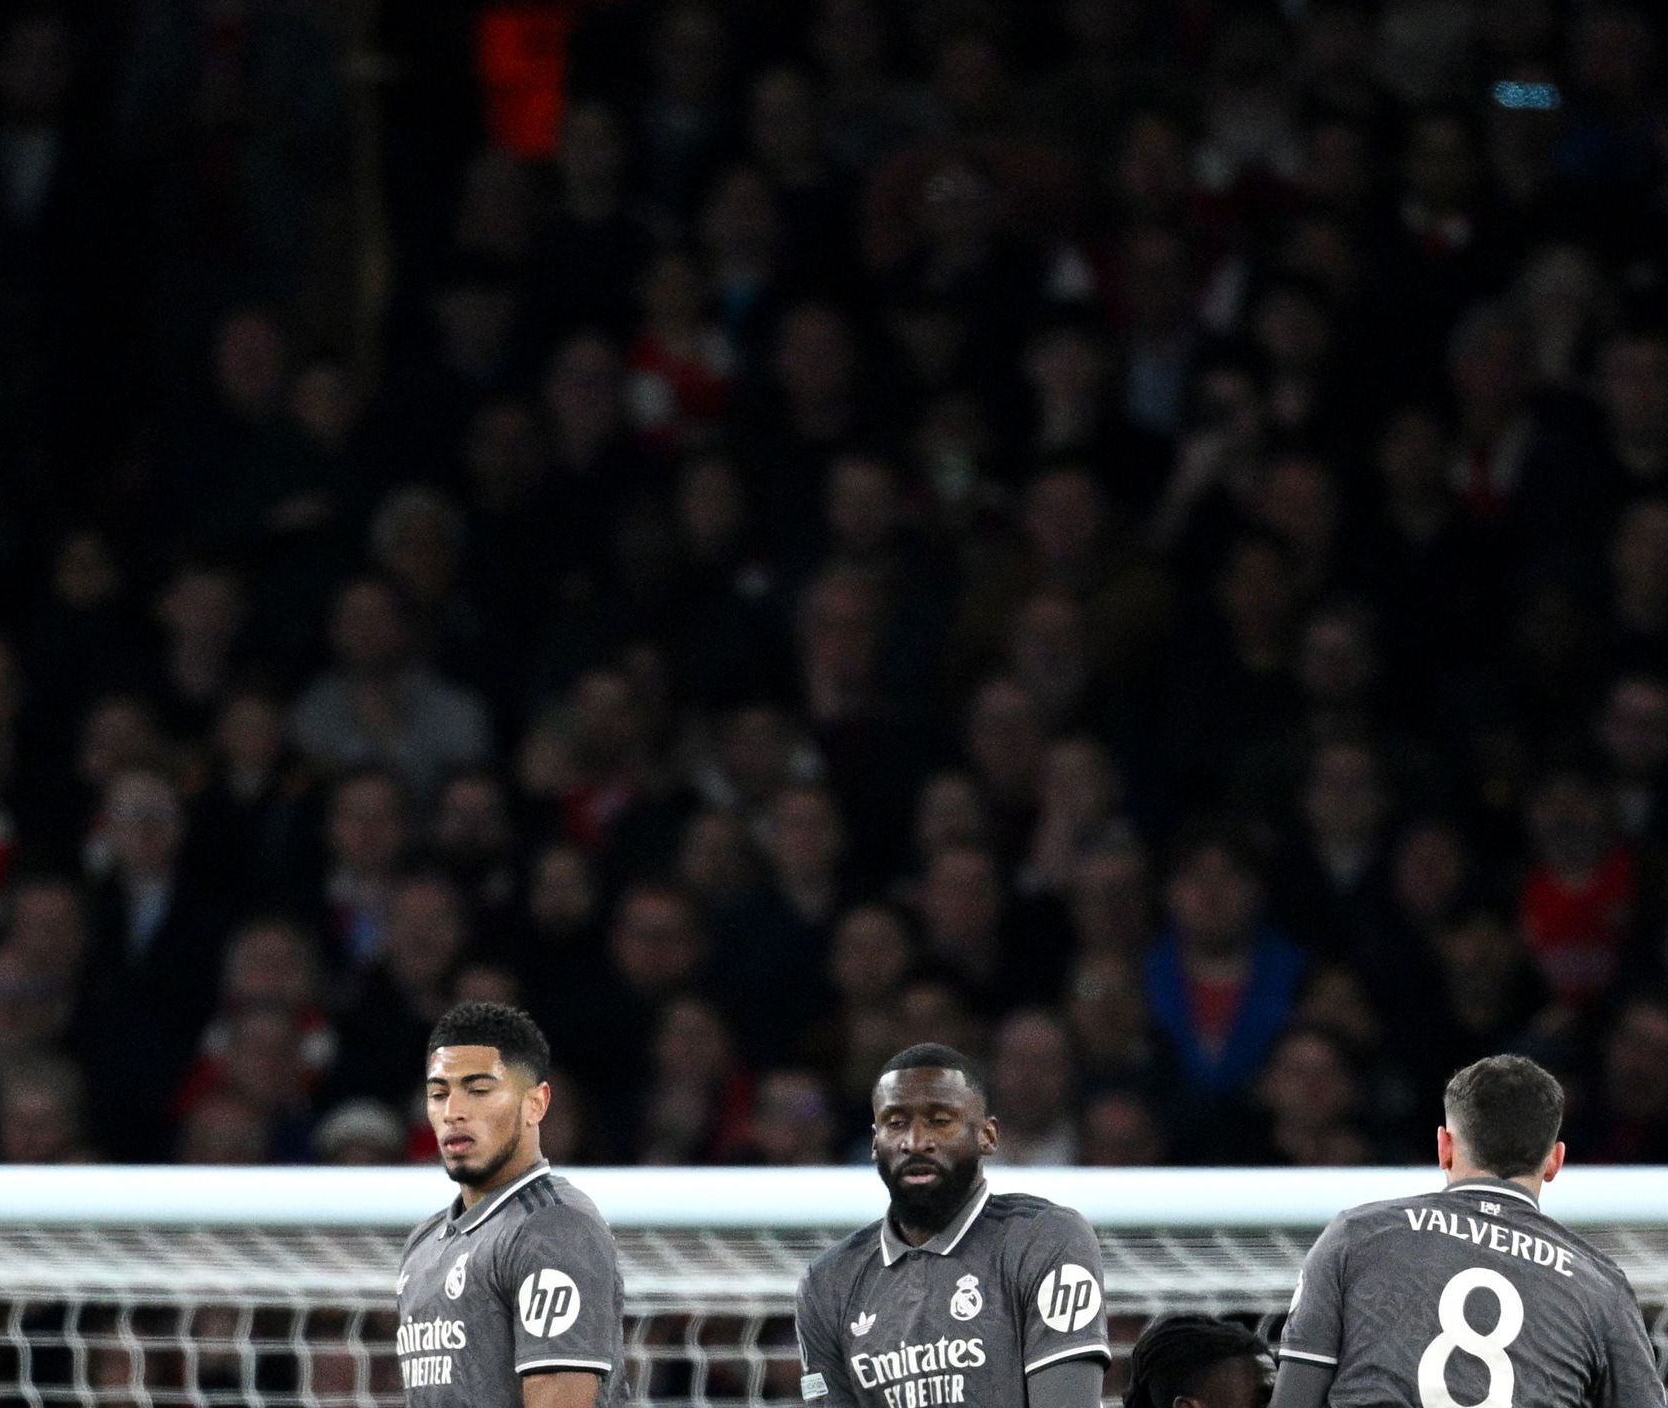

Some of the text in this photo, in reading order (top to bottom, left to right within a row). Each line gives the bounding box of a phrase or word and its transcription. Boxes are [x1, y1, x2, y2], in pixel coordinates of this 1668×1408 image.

[1405, 1208, 1574, 1278] VALVERDE
[523, 1268, 576, 1337] hp
[1044, 1264, 1095, 1332] hp
[411, 1355, 452, 1387] BETTER
[851, 1335, 986, 1389] Emirates
